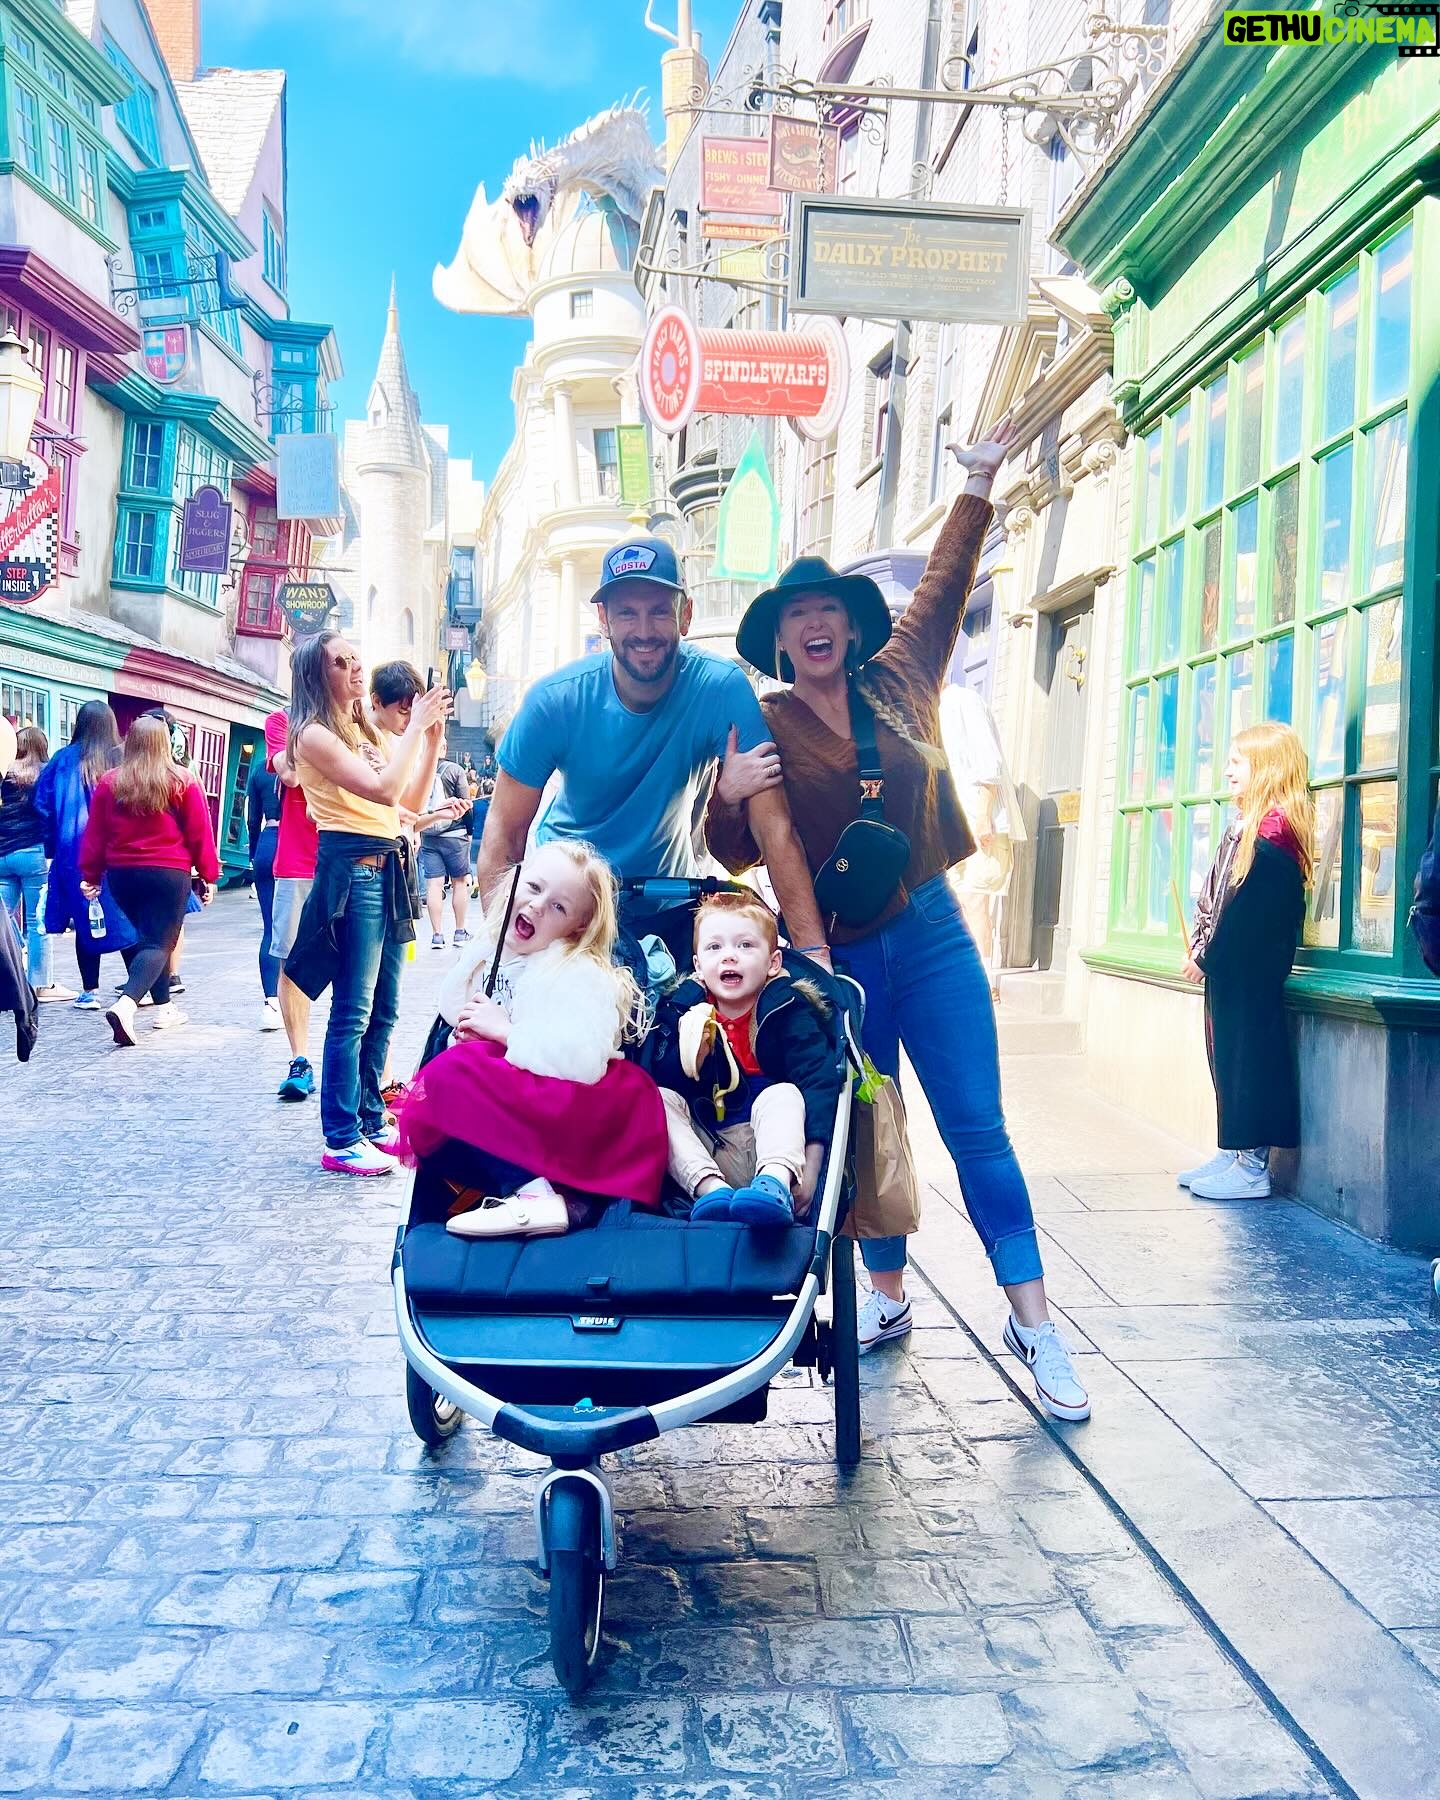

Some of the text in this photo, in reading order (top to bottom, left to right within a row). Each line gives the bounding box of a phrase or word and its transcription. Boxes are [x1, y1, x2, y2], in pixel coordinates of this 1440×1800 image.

[704, 148, 738, 165] BREWS
[898, 220, 921, 249] The
[813, 241, 1008, 273] DAILY PROPHET
[703, 359, 828, 386] SPINDLEWARPS
[195, 510, 220, 519] SLUG
[186, 527, 225, 538] JIGGERS
[6, 567, 28, 579] STEP
[615, 561, 647, 573] COSTA
[2, 580, 31, 592] INSIDE
[285, 587, 328, 599] WAND
[285, 600, 328, 609] SHOWROOM
[579, 1316, 615, 1326] THULE
